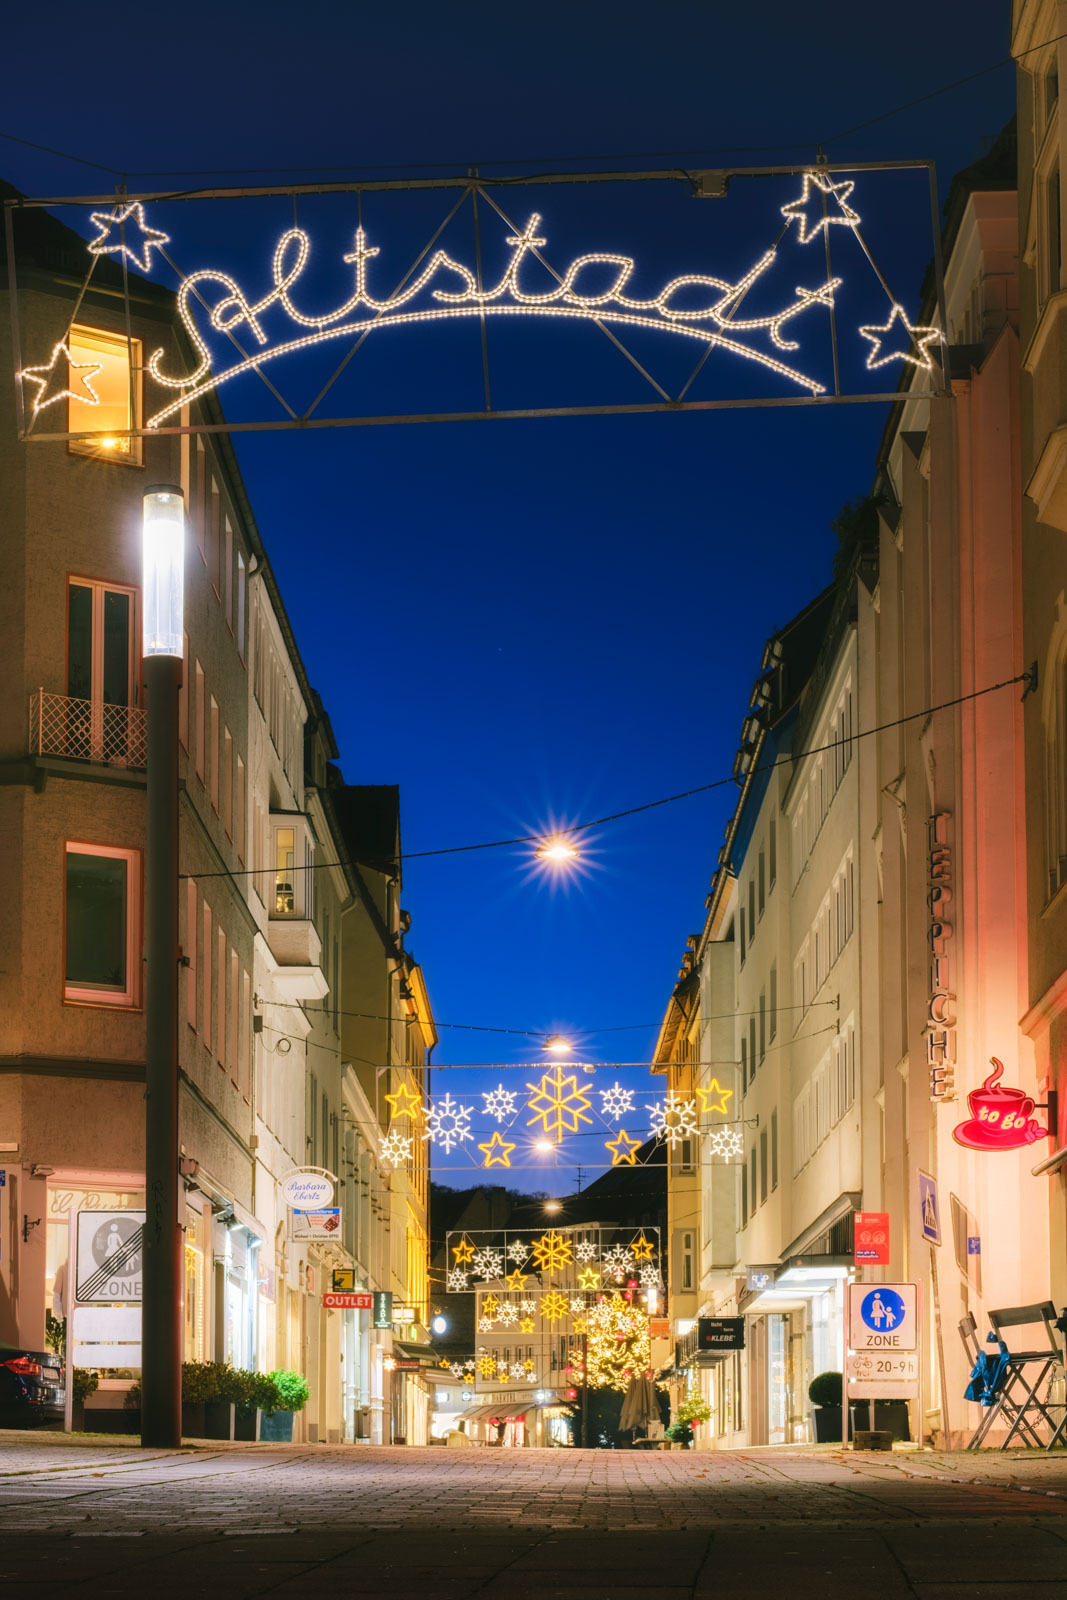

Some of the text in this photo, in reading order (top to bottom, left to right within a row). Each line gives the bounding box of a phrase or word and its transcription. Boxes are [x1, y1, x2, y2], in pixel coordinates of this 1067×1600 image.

[148, 213, 843, 388] Altstadt
[927, 811, 957, 1102] TEPPICHE
[978, 1106, 1026, 1130] to go
[288, 1182, 326, 1191] Barbara
[294, 1192, 320, 1200] Ebertz
[99, 1281, 142, 1296] ZONE
[325, 1296, 370, 1306] OUTLET
[866, 1335, 900, 1346] ZONE
[877, 1360, 914, 1373] 20-9 h
